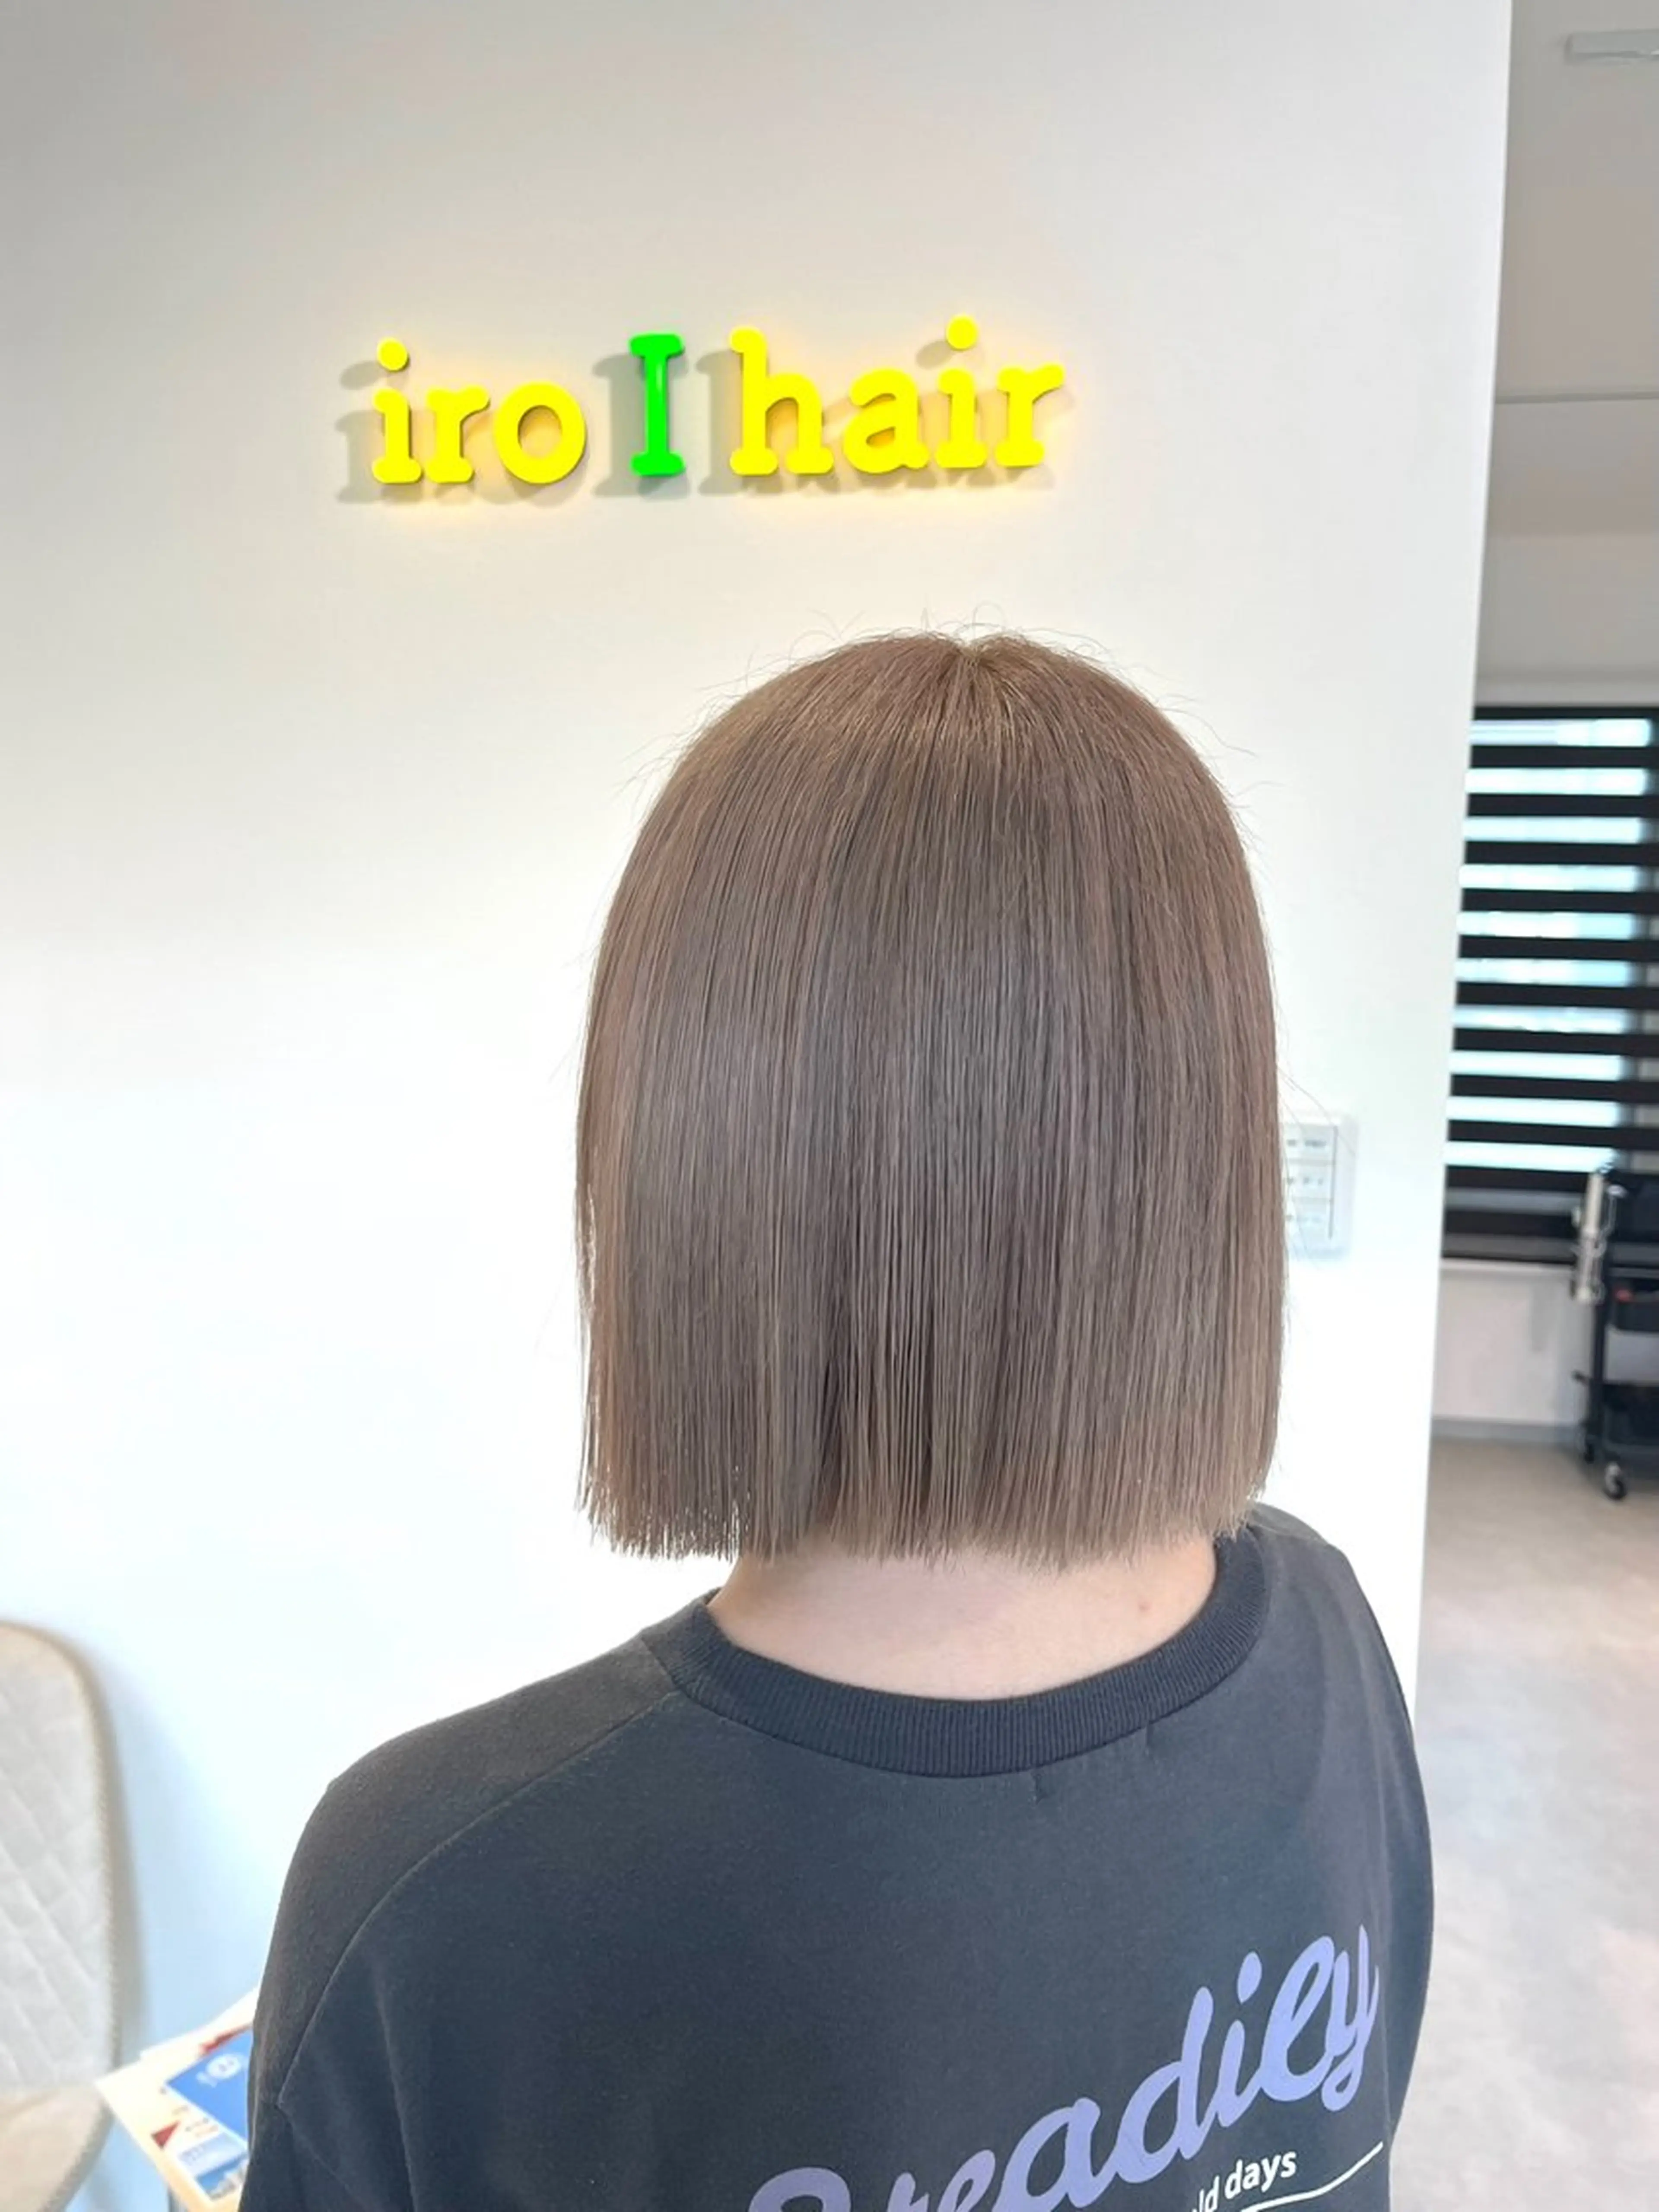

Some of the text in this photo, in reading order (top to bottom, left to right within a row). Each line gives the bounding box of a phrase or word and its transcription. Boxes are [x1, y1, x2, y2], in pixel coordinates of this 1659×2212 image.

[372, 338, 587, 486] iro
[730, 316, 1065, 477] hair
[1191, 2151, 1297, 2212] ld days
